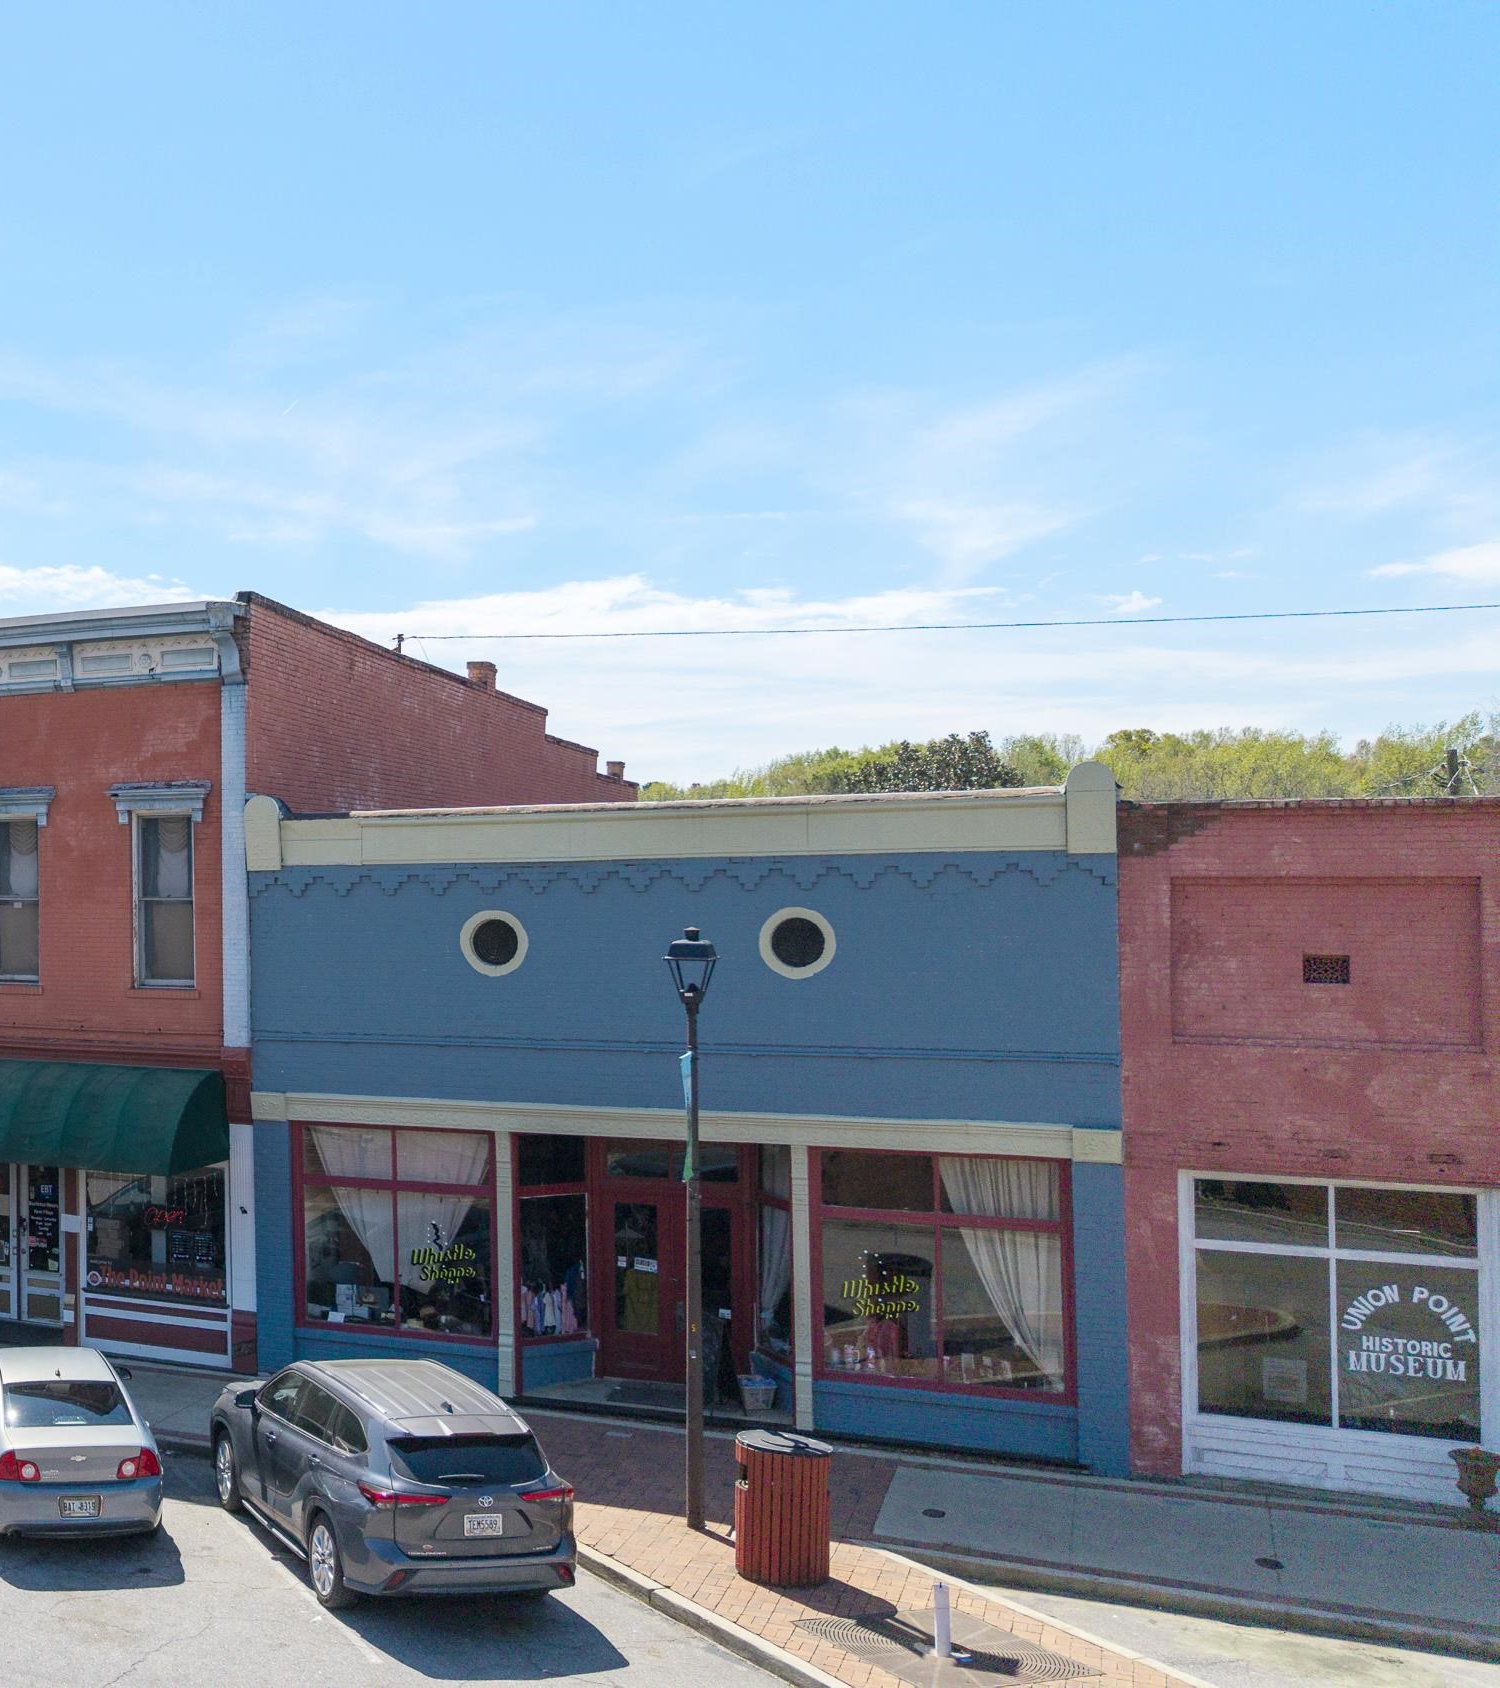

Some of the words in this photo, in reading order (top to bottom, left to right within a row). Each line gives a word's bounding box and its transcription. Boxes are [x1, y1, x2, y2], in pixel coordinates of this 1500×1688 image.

[40, 1184, 53, 1193] EBT
[99, 1263, 125, 1288] The
[129, 1267, 167, 1292] Point
[171, 1272, 224, 1299] Market
[1341, 1284, 1400, 1330] UNION
[1412, 1286, 1476, 1343] POINT
[1362, 1335, 1453, 1358] HISTORIC
[1348, 1350, 1467, 1381] MUSEUM
